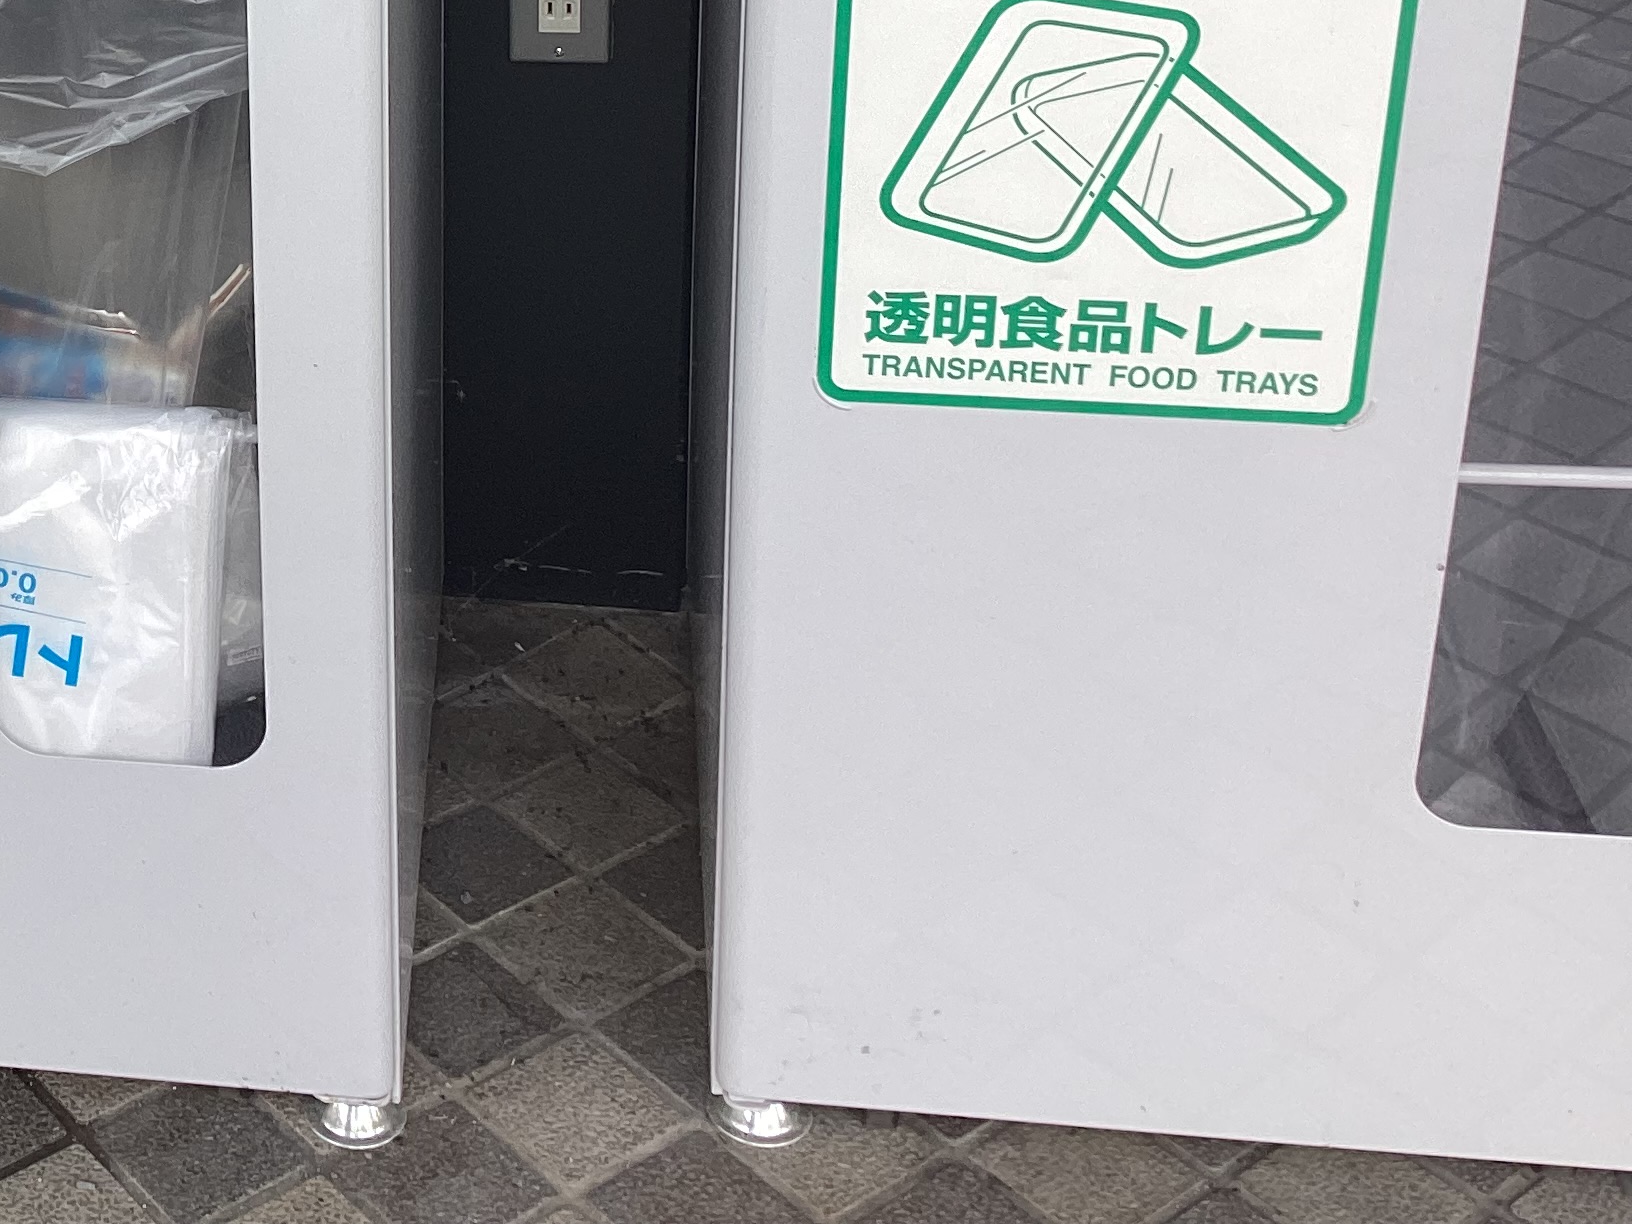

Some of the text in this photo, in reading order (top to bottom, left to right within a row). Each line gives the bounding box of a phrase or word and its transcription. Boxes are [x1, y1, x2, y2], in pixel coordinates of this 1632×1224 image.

[864, 289, 1323, 356] 透明食品トレー
[862, 353, 1319, 397] TRANSPARENT FOOD TRAYS
